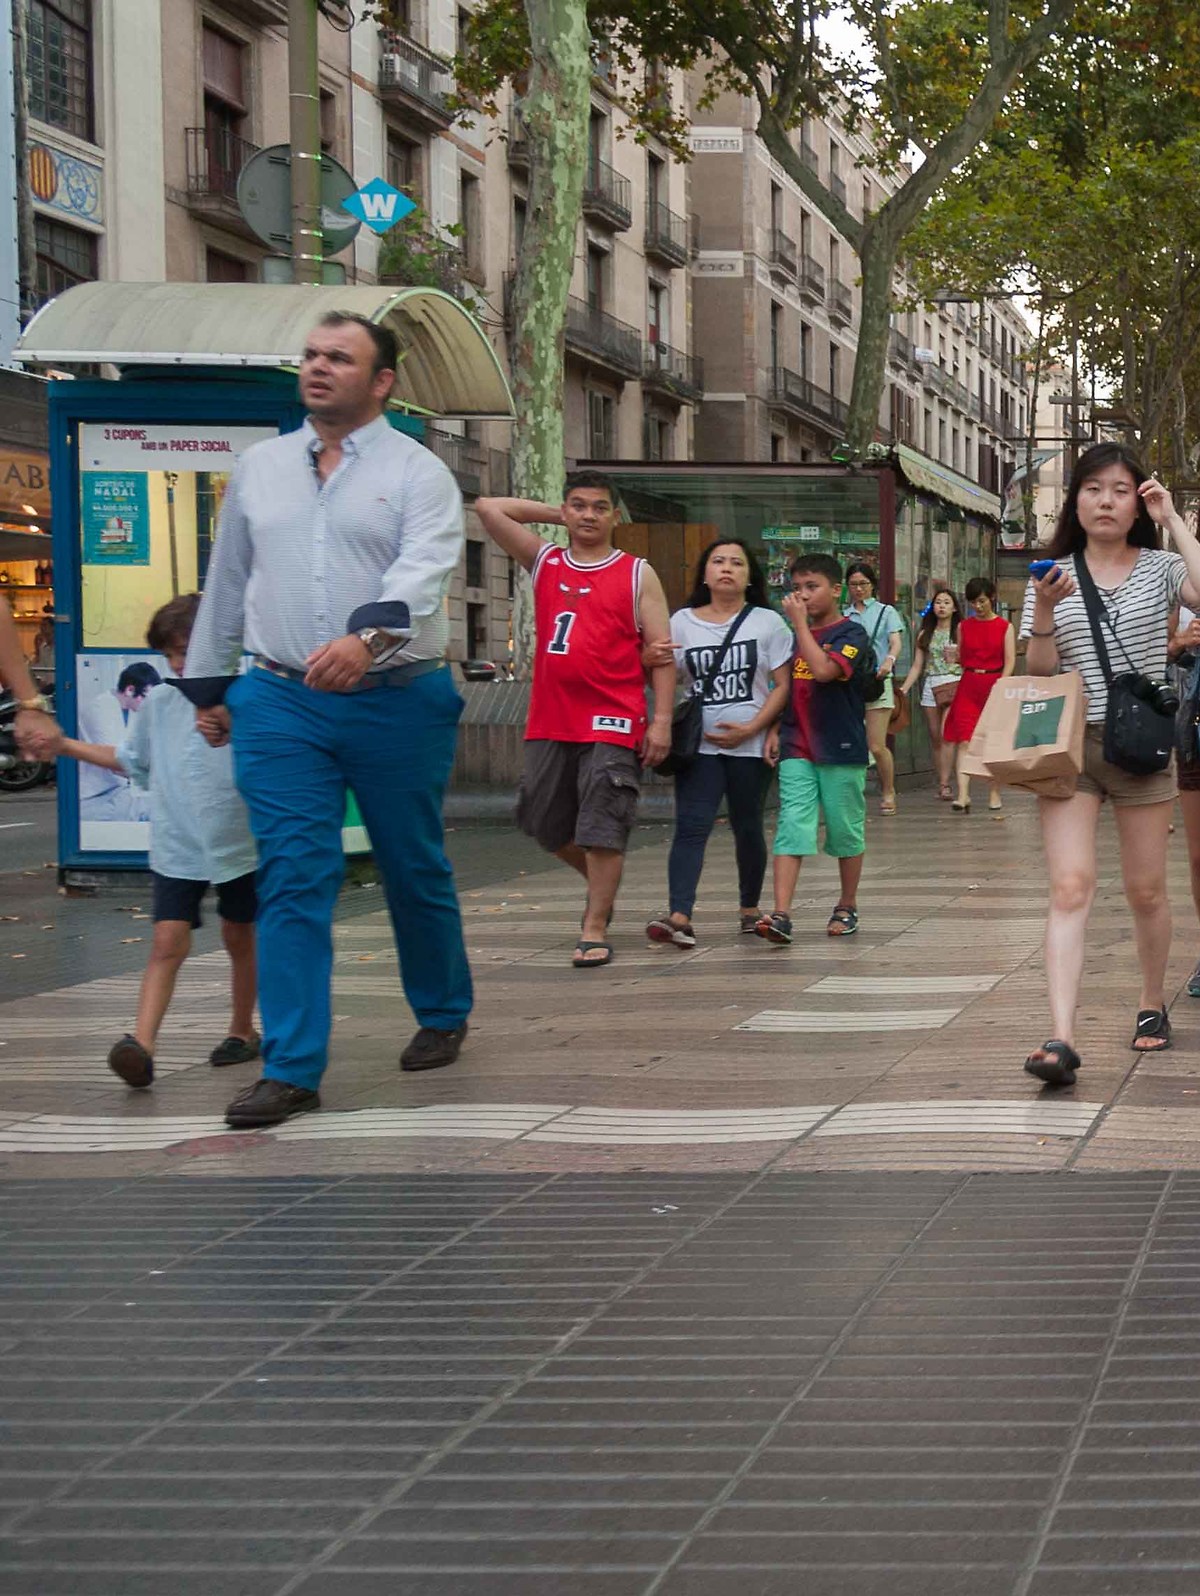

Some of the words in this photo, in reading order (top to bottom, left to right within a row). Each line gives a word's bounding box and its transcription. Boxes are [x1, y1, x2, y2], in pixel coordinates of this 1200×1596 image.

[360, 193, 397, 222] W
[104, 429, 111, 441] 3
[112, 429, 148, 441] CUPONS
[170, 440, 199, 452] PAPER
[200, 440, 232, 453] SOCIAL
[547, 611, 577, 655] 1
[1021, 702, 1048, 715] an
